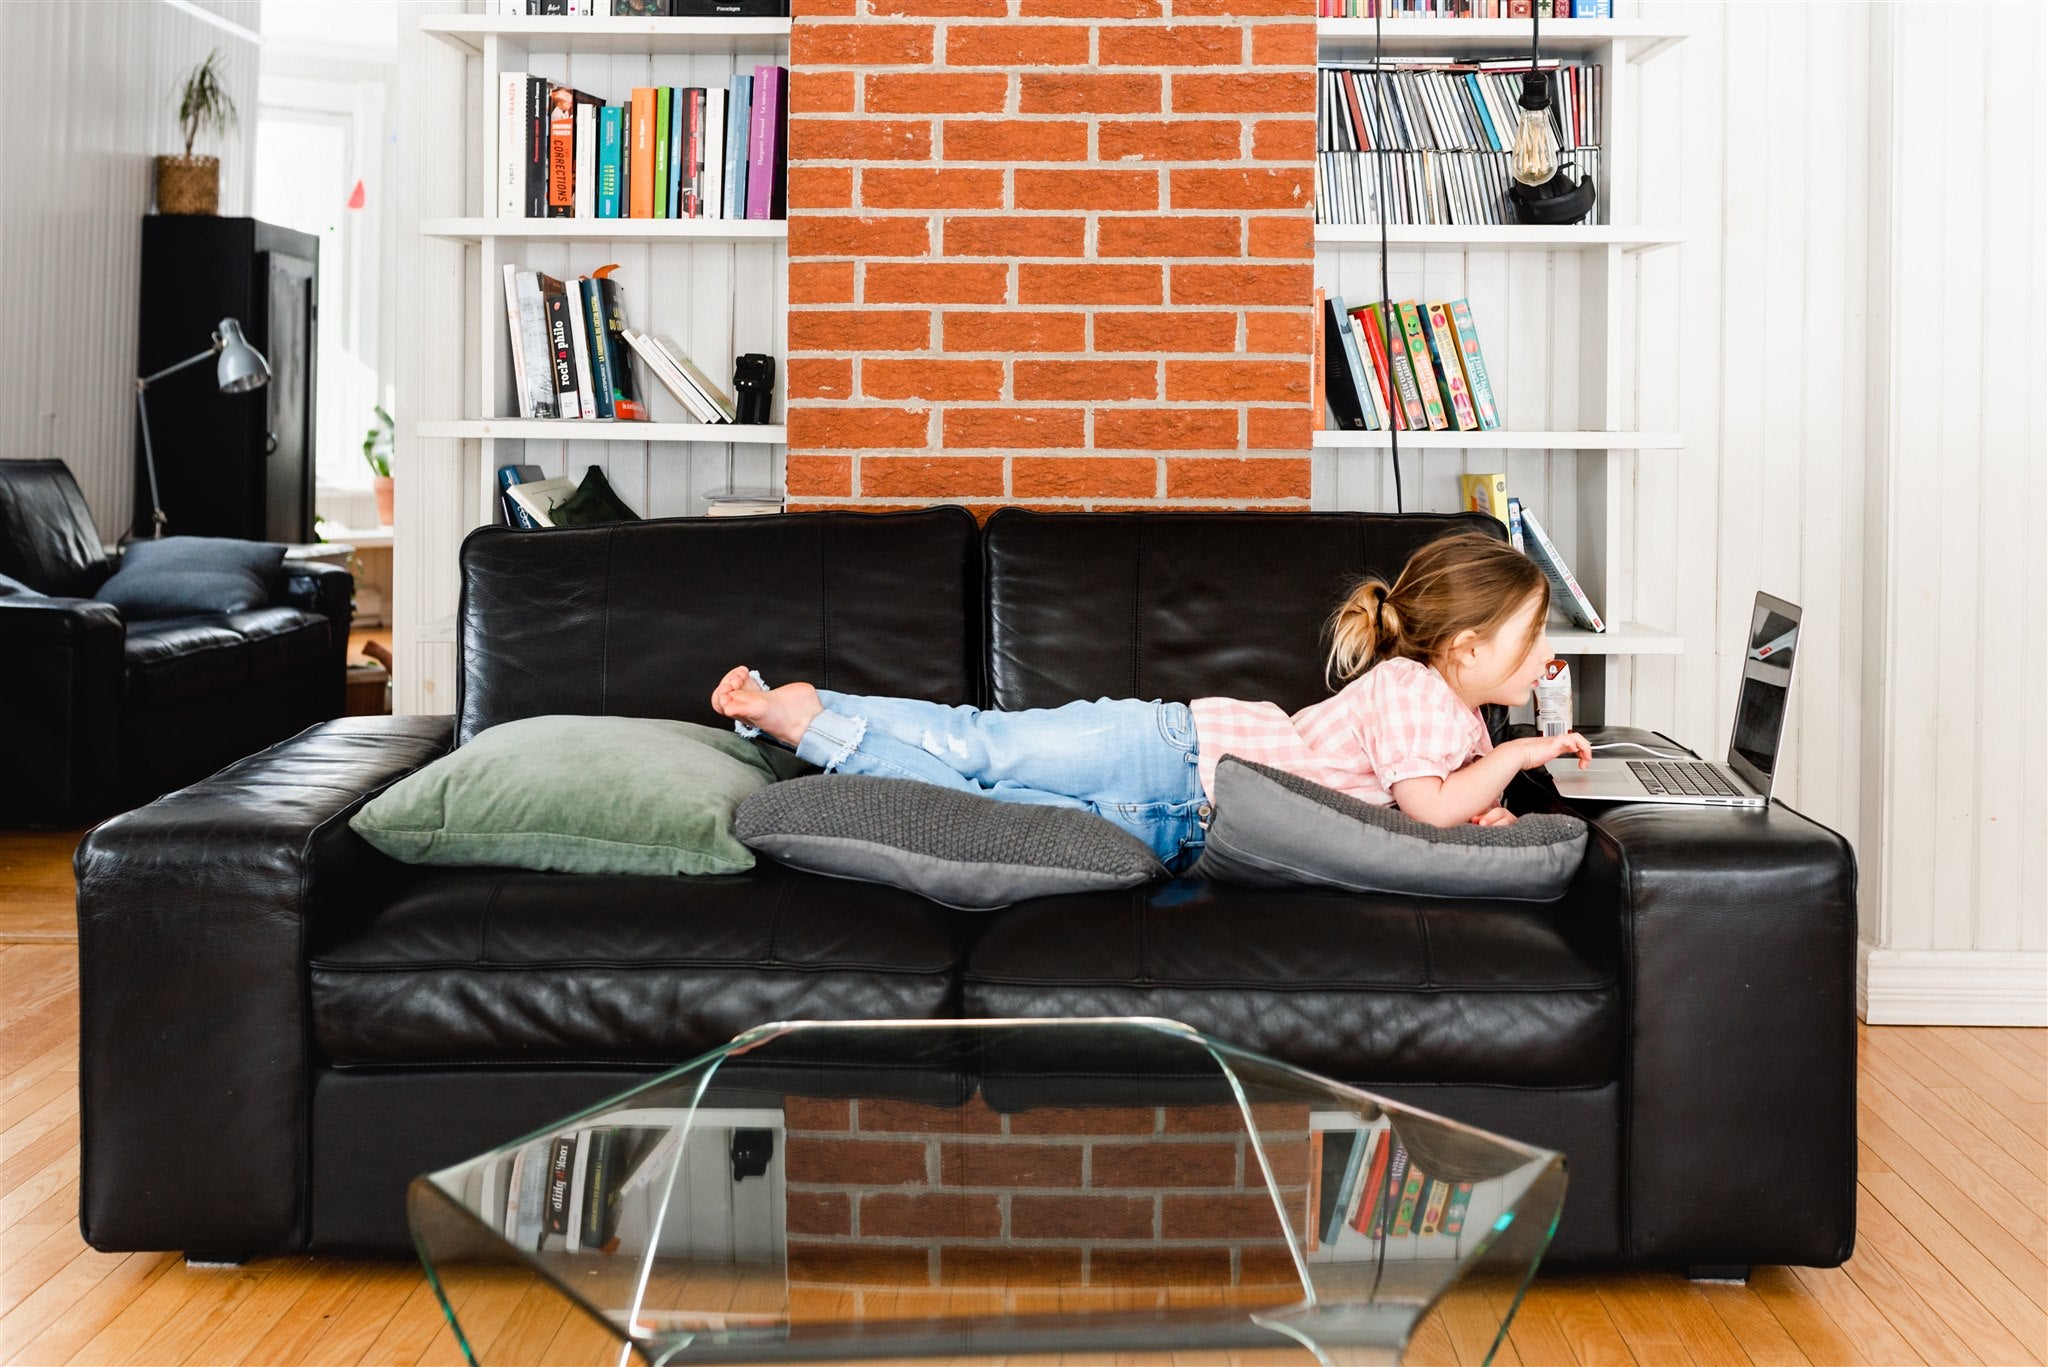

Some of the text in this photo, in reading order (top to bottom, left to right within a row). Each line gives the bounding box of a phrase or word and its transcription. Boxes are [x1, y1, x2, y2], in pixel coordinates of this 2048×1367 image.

[508, 82, 516, 116] FRANZEN
[553, 140, 568, 202] CORRECTIONS
[553, 320, 570, 386] rock'n philo
